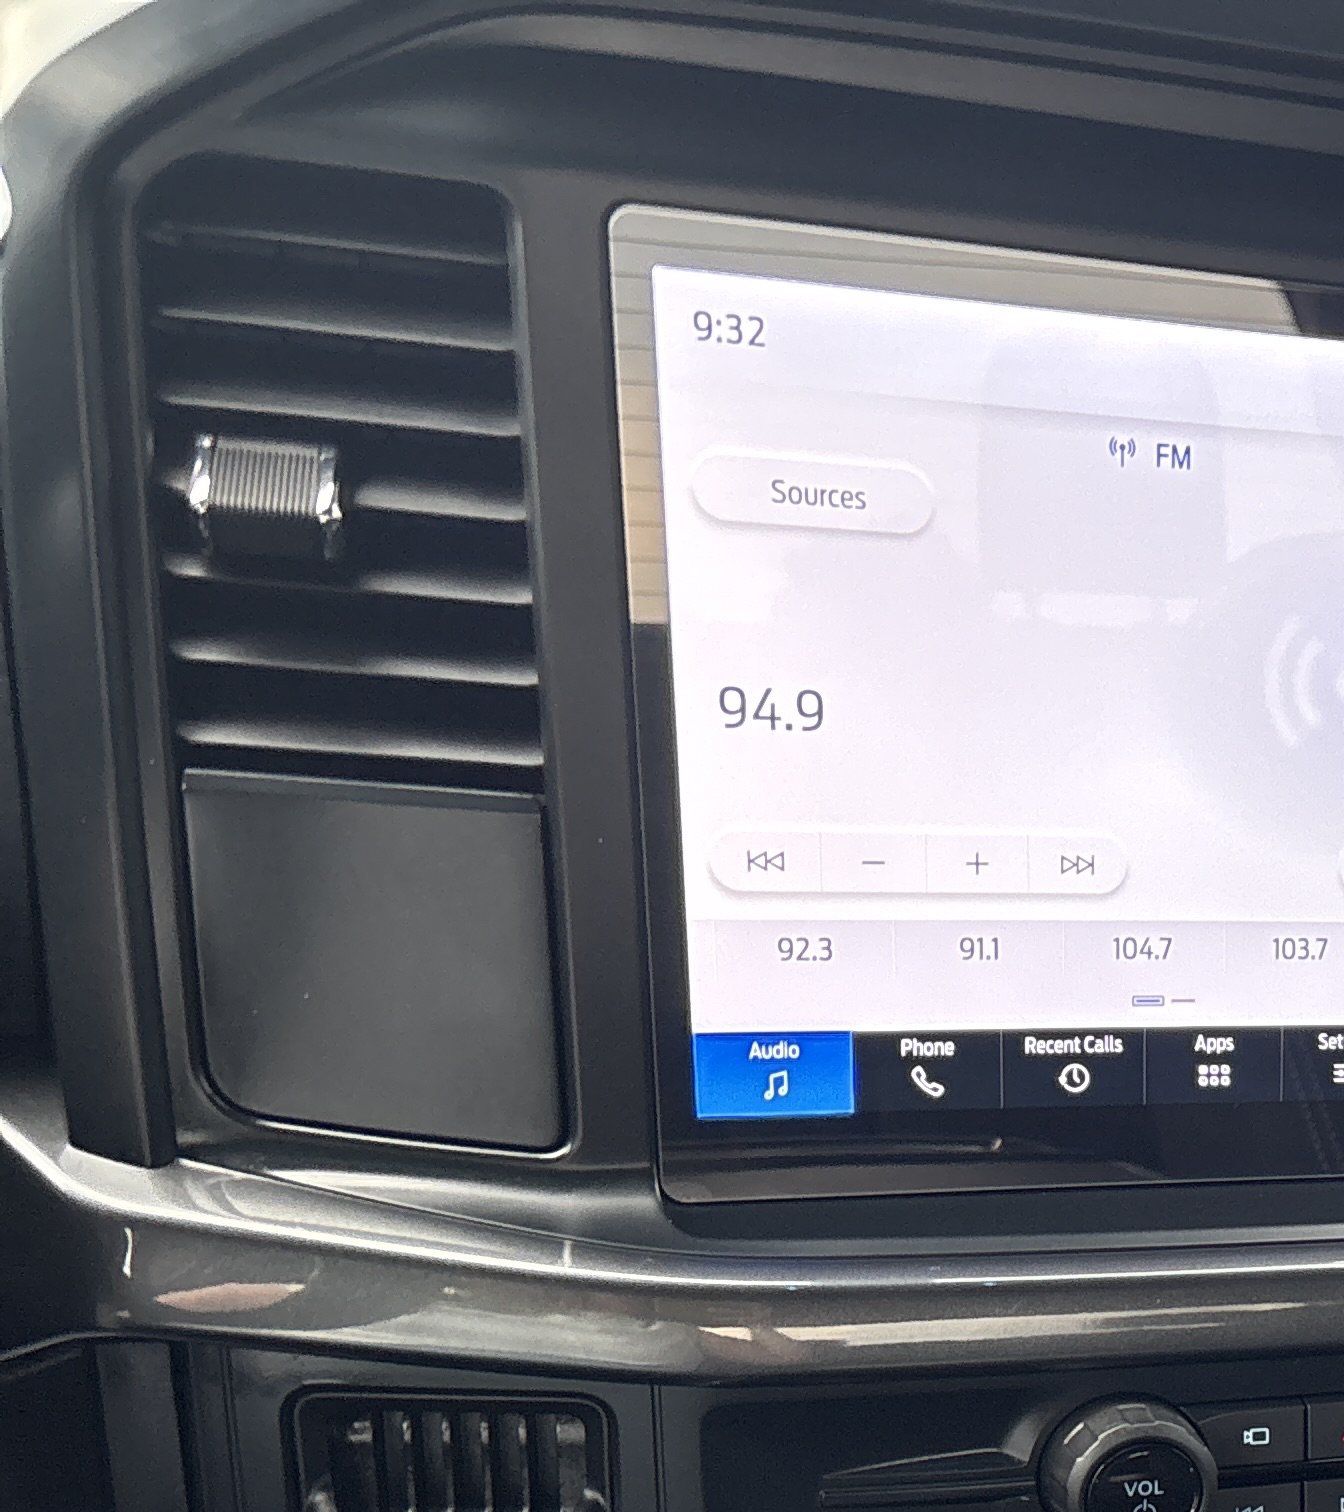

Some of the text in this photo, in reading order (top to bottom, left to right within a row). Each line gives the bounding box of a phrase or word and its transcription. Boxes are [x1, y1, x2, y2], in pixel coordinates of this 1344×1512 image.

[693, 310, 766, 348] 9:32
[1156, 443, 1191, 471] FM
[771, 479, 867, 510] Sources
[718, 686, 824, 732] 94.9
[777, 937, 833, 962] 92.3
[959, 936, 999, 961] 91.1
[1112, 936, 1173, 961] 104.7
[1272, 937, 1329, 961] 103.7
[748, 1040, 800, 1060] Audio
[900, 1037, 955, 1057] Phone
[1024, 1034, 1124, 1055] Recent Calls
[1193, 1033, 1235, 1055] Apps
[1123, 1479, 1165, 1497] VOL
